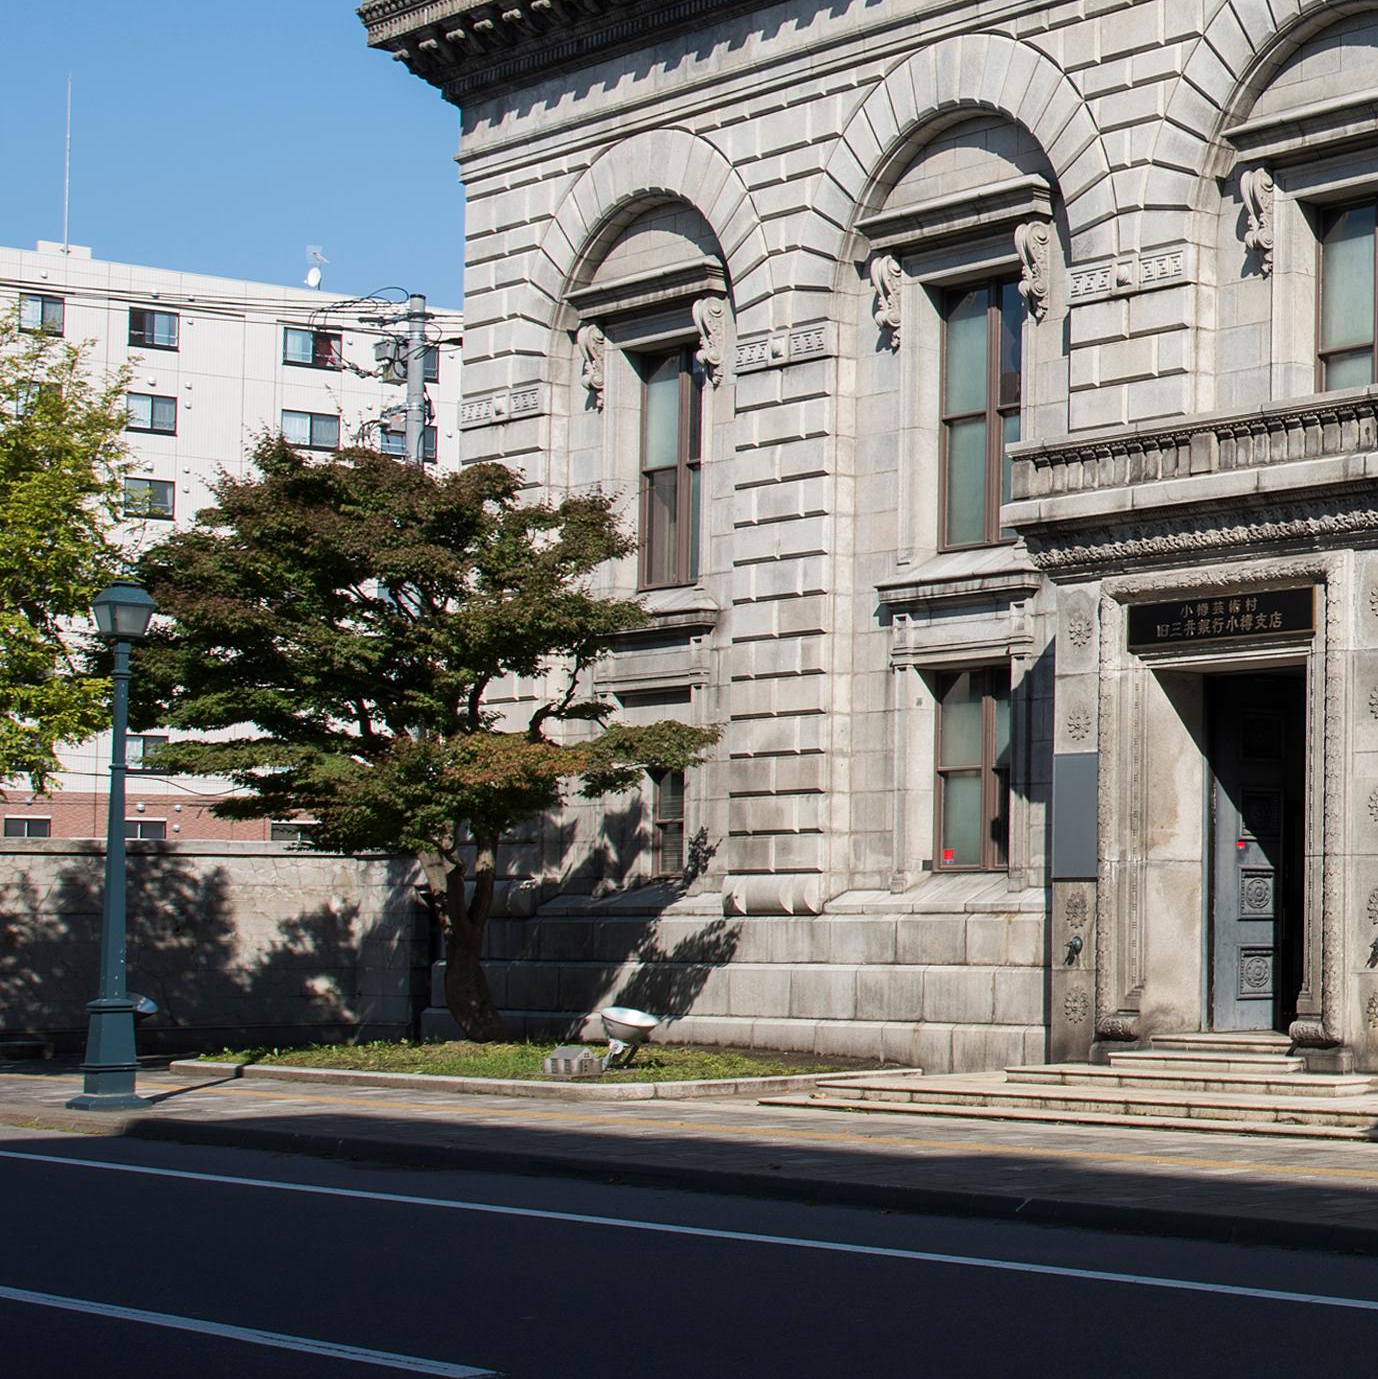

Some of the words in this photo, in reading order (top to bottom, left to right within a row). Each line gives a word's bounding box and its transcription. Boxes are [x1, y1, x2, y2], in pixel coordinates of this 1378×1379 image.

[1180, 597, 1258, 618] 小樽芸術村
[1156, 611, 1283, 638] 旧三井銀行小樽支店
